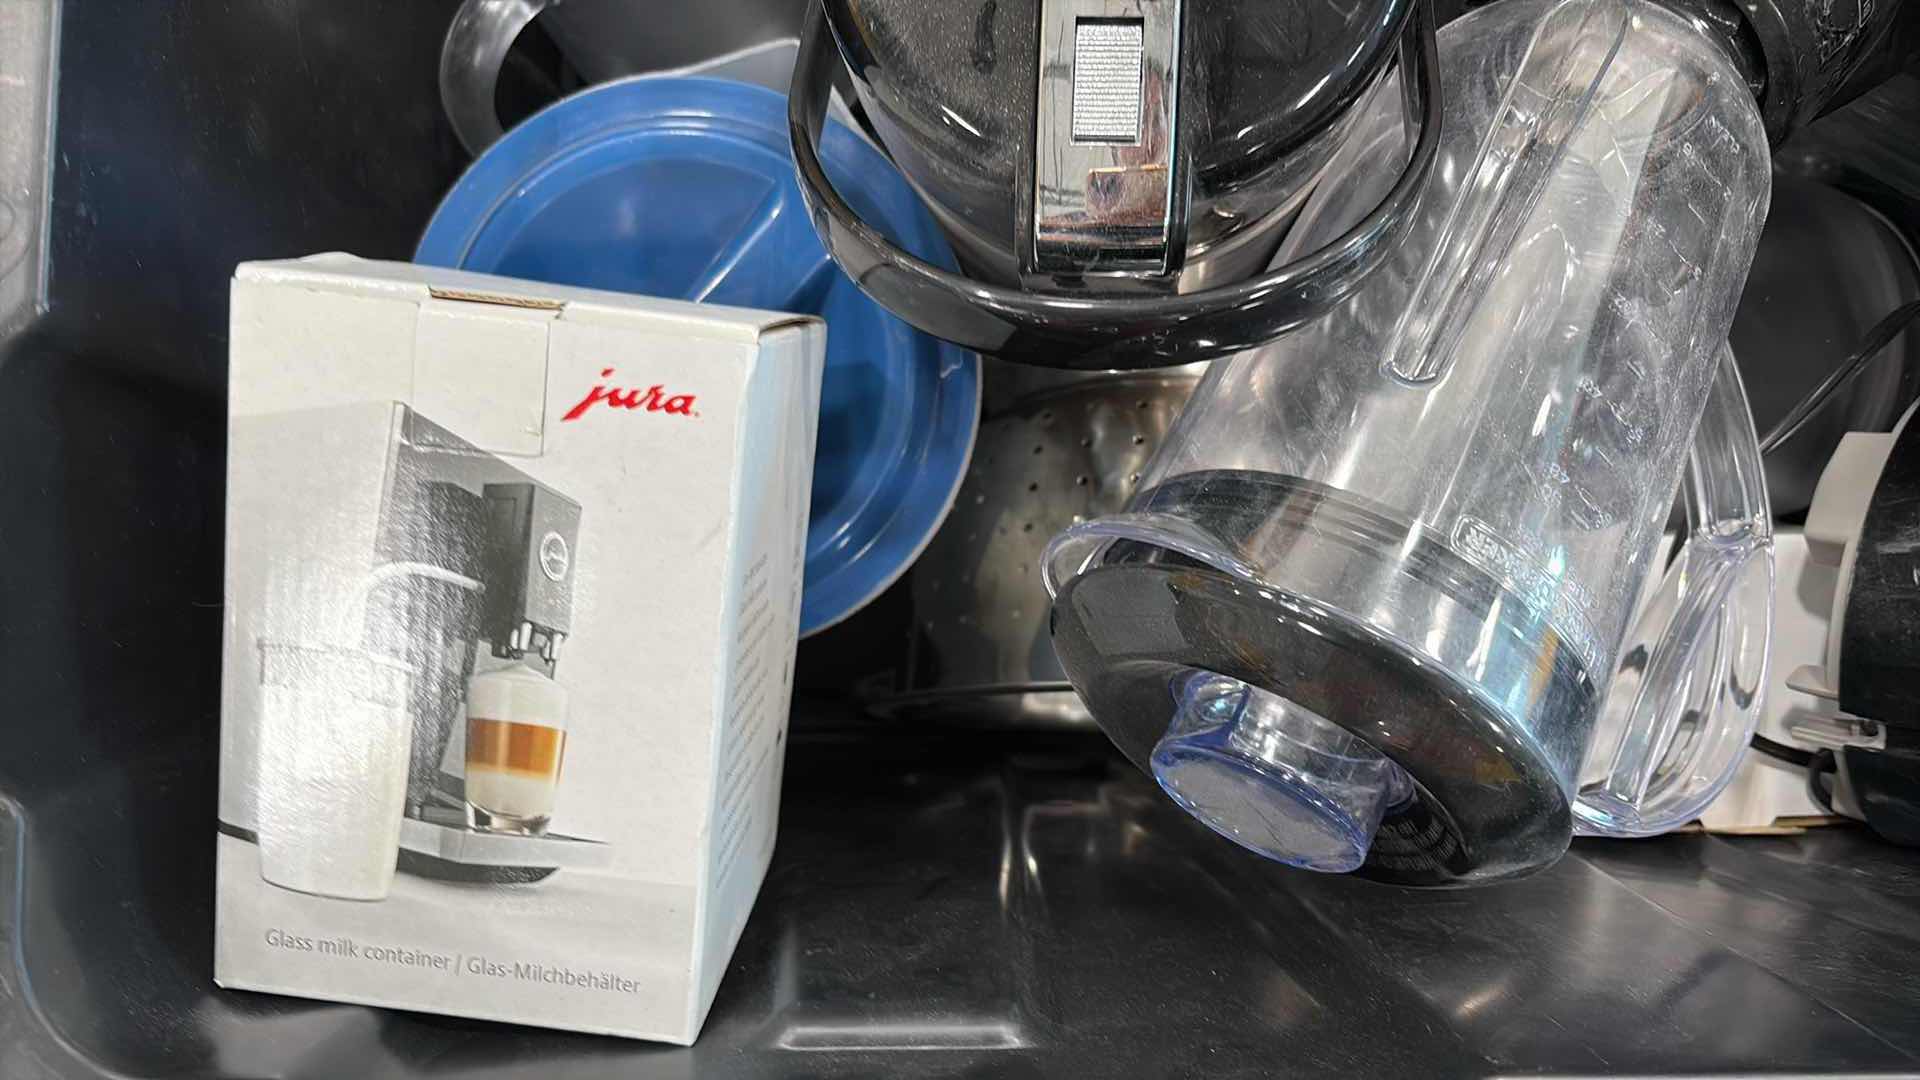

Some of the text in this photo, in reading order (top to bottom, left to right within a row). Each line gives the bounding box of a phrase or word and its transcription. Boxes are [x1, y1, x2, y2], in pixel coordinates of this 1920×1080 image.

[559, 367, 698, 422] jura
[265, 927, 641, 993] Glass milk container / Glas-Milchbehälter
